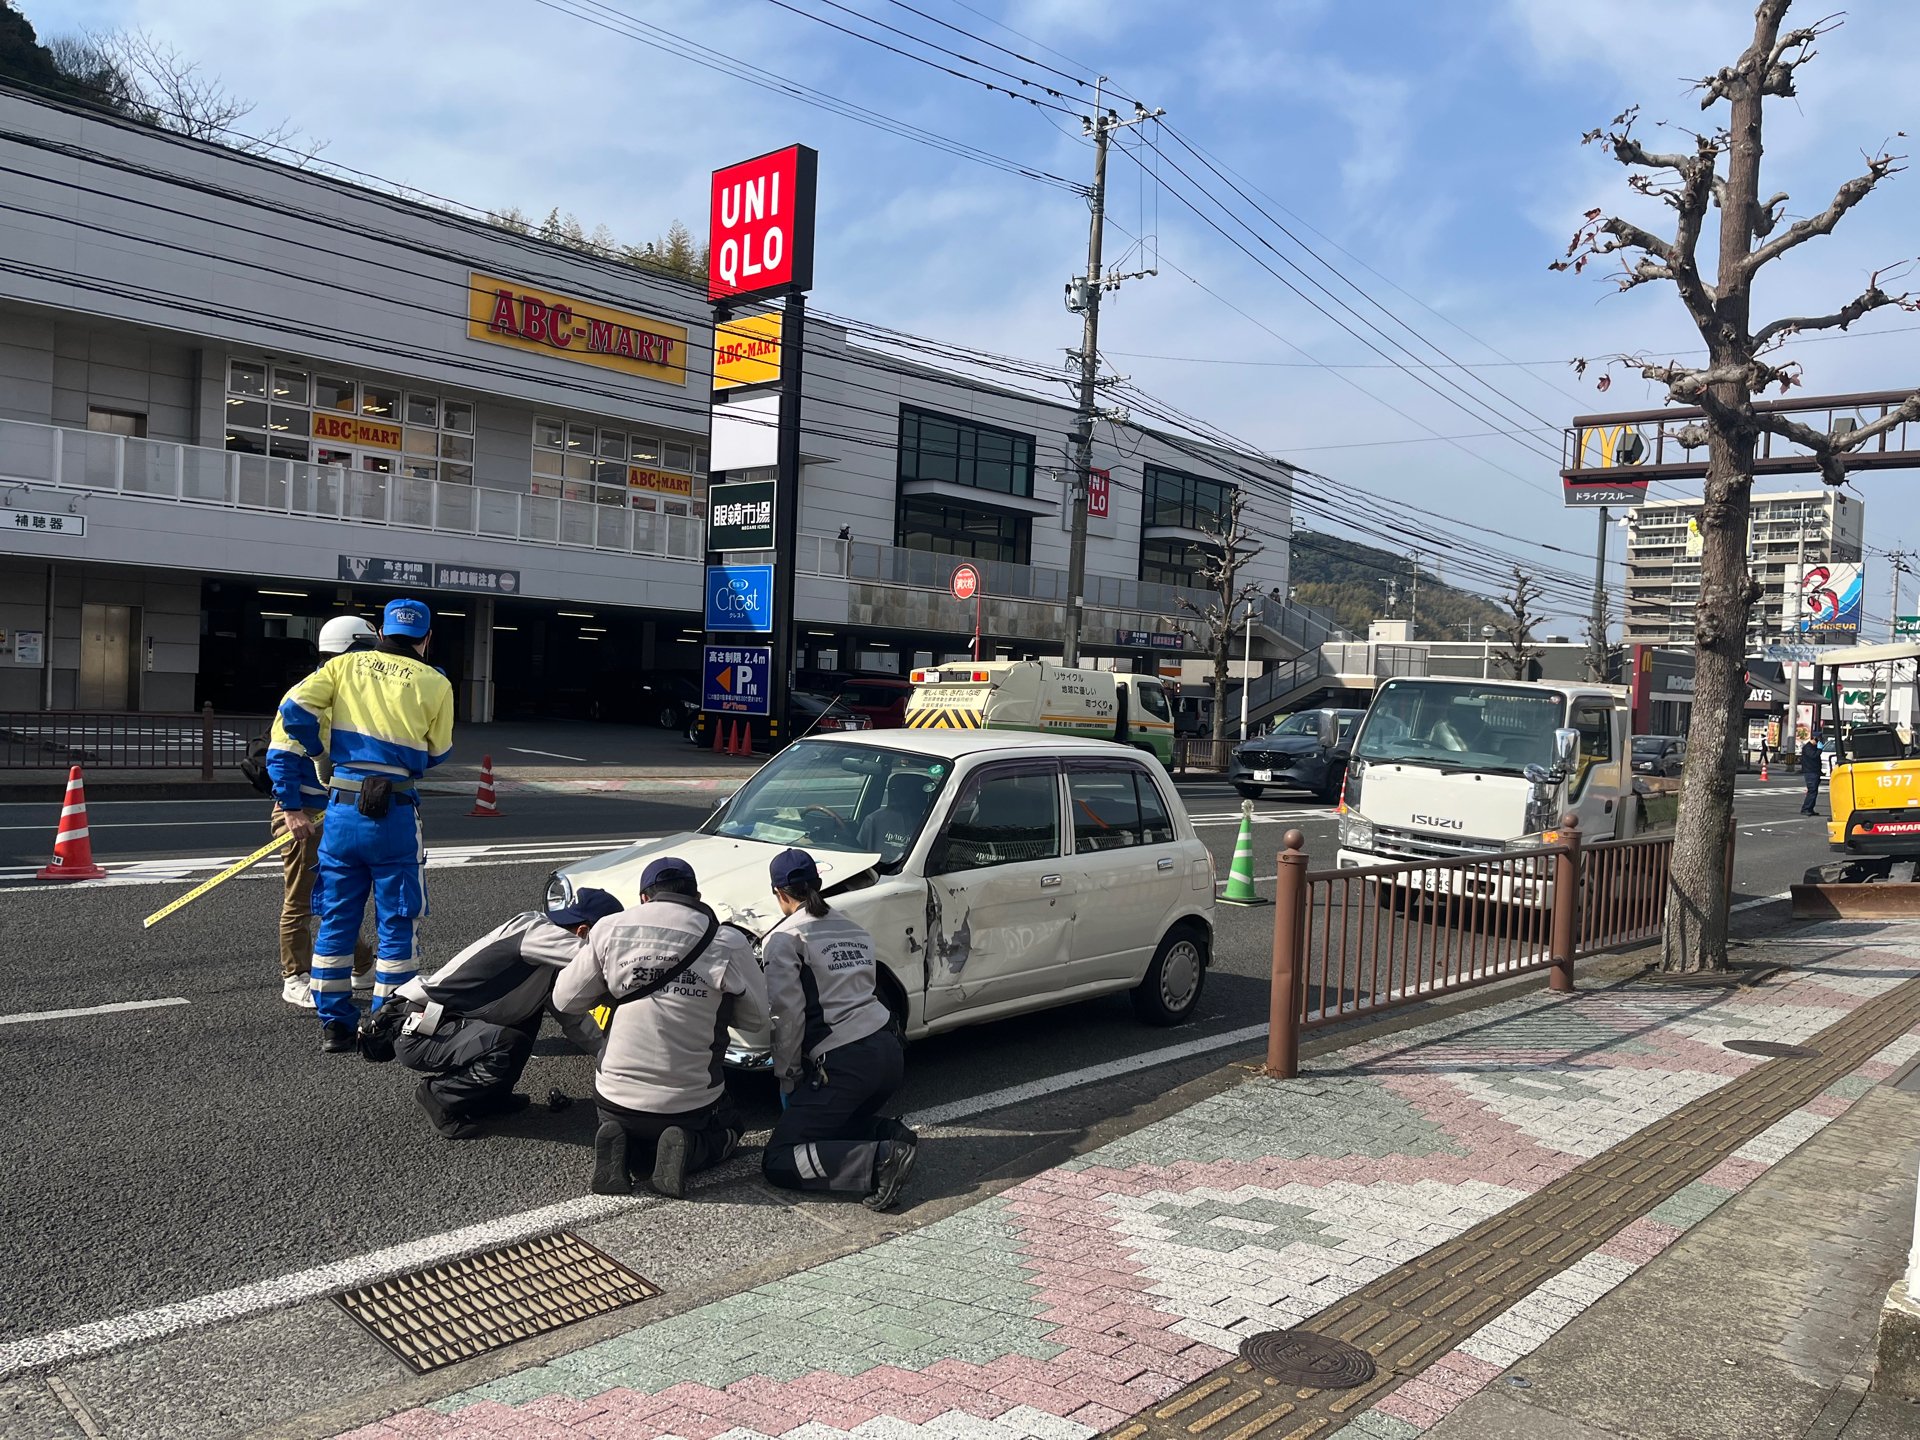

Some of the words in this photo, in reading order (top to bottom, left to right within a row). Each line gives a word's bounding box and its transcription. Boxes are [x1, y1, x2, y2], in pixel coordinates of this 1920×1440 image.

[721, 171, 780, 229] UNI
[719, 226, 783, 287] QLO
[488, 288, 674, 366] ABC-MART
[716, 337, 778, 365] ABC-MART
[314, 417, 400, 445] ABC-MART
[629, 469, 690, 492] ABC-MART
[1087, 493, 1106, 511] LO
[1576, 492, 1634, 501] ドライブスルー
[15, 514, 63, 530] 補聴器
[713, 501, 770, 527] 眼鏡市場
[383, 561, 423, 573] 高さ制限
[392, 571, 417, 581] 2.4m
[716, 587, 760, 611] Crest
[396, 612, 415, 621] POLICE
[709, 651, 742, 663] 高さ制限
[744, 652, 766, 664] 2.4m
[736, 665, 753, 695] P
[1053, 671, 1084, 682] リサイクル
[747, 684, 758, 695] IN
[1876, 774, 1913, 788] 1577
[1411, 813, 1463, 830] ISUZU
[620, 955, 651, 968] TRAFFIC
[673, 986, 708, 998] POLICE
